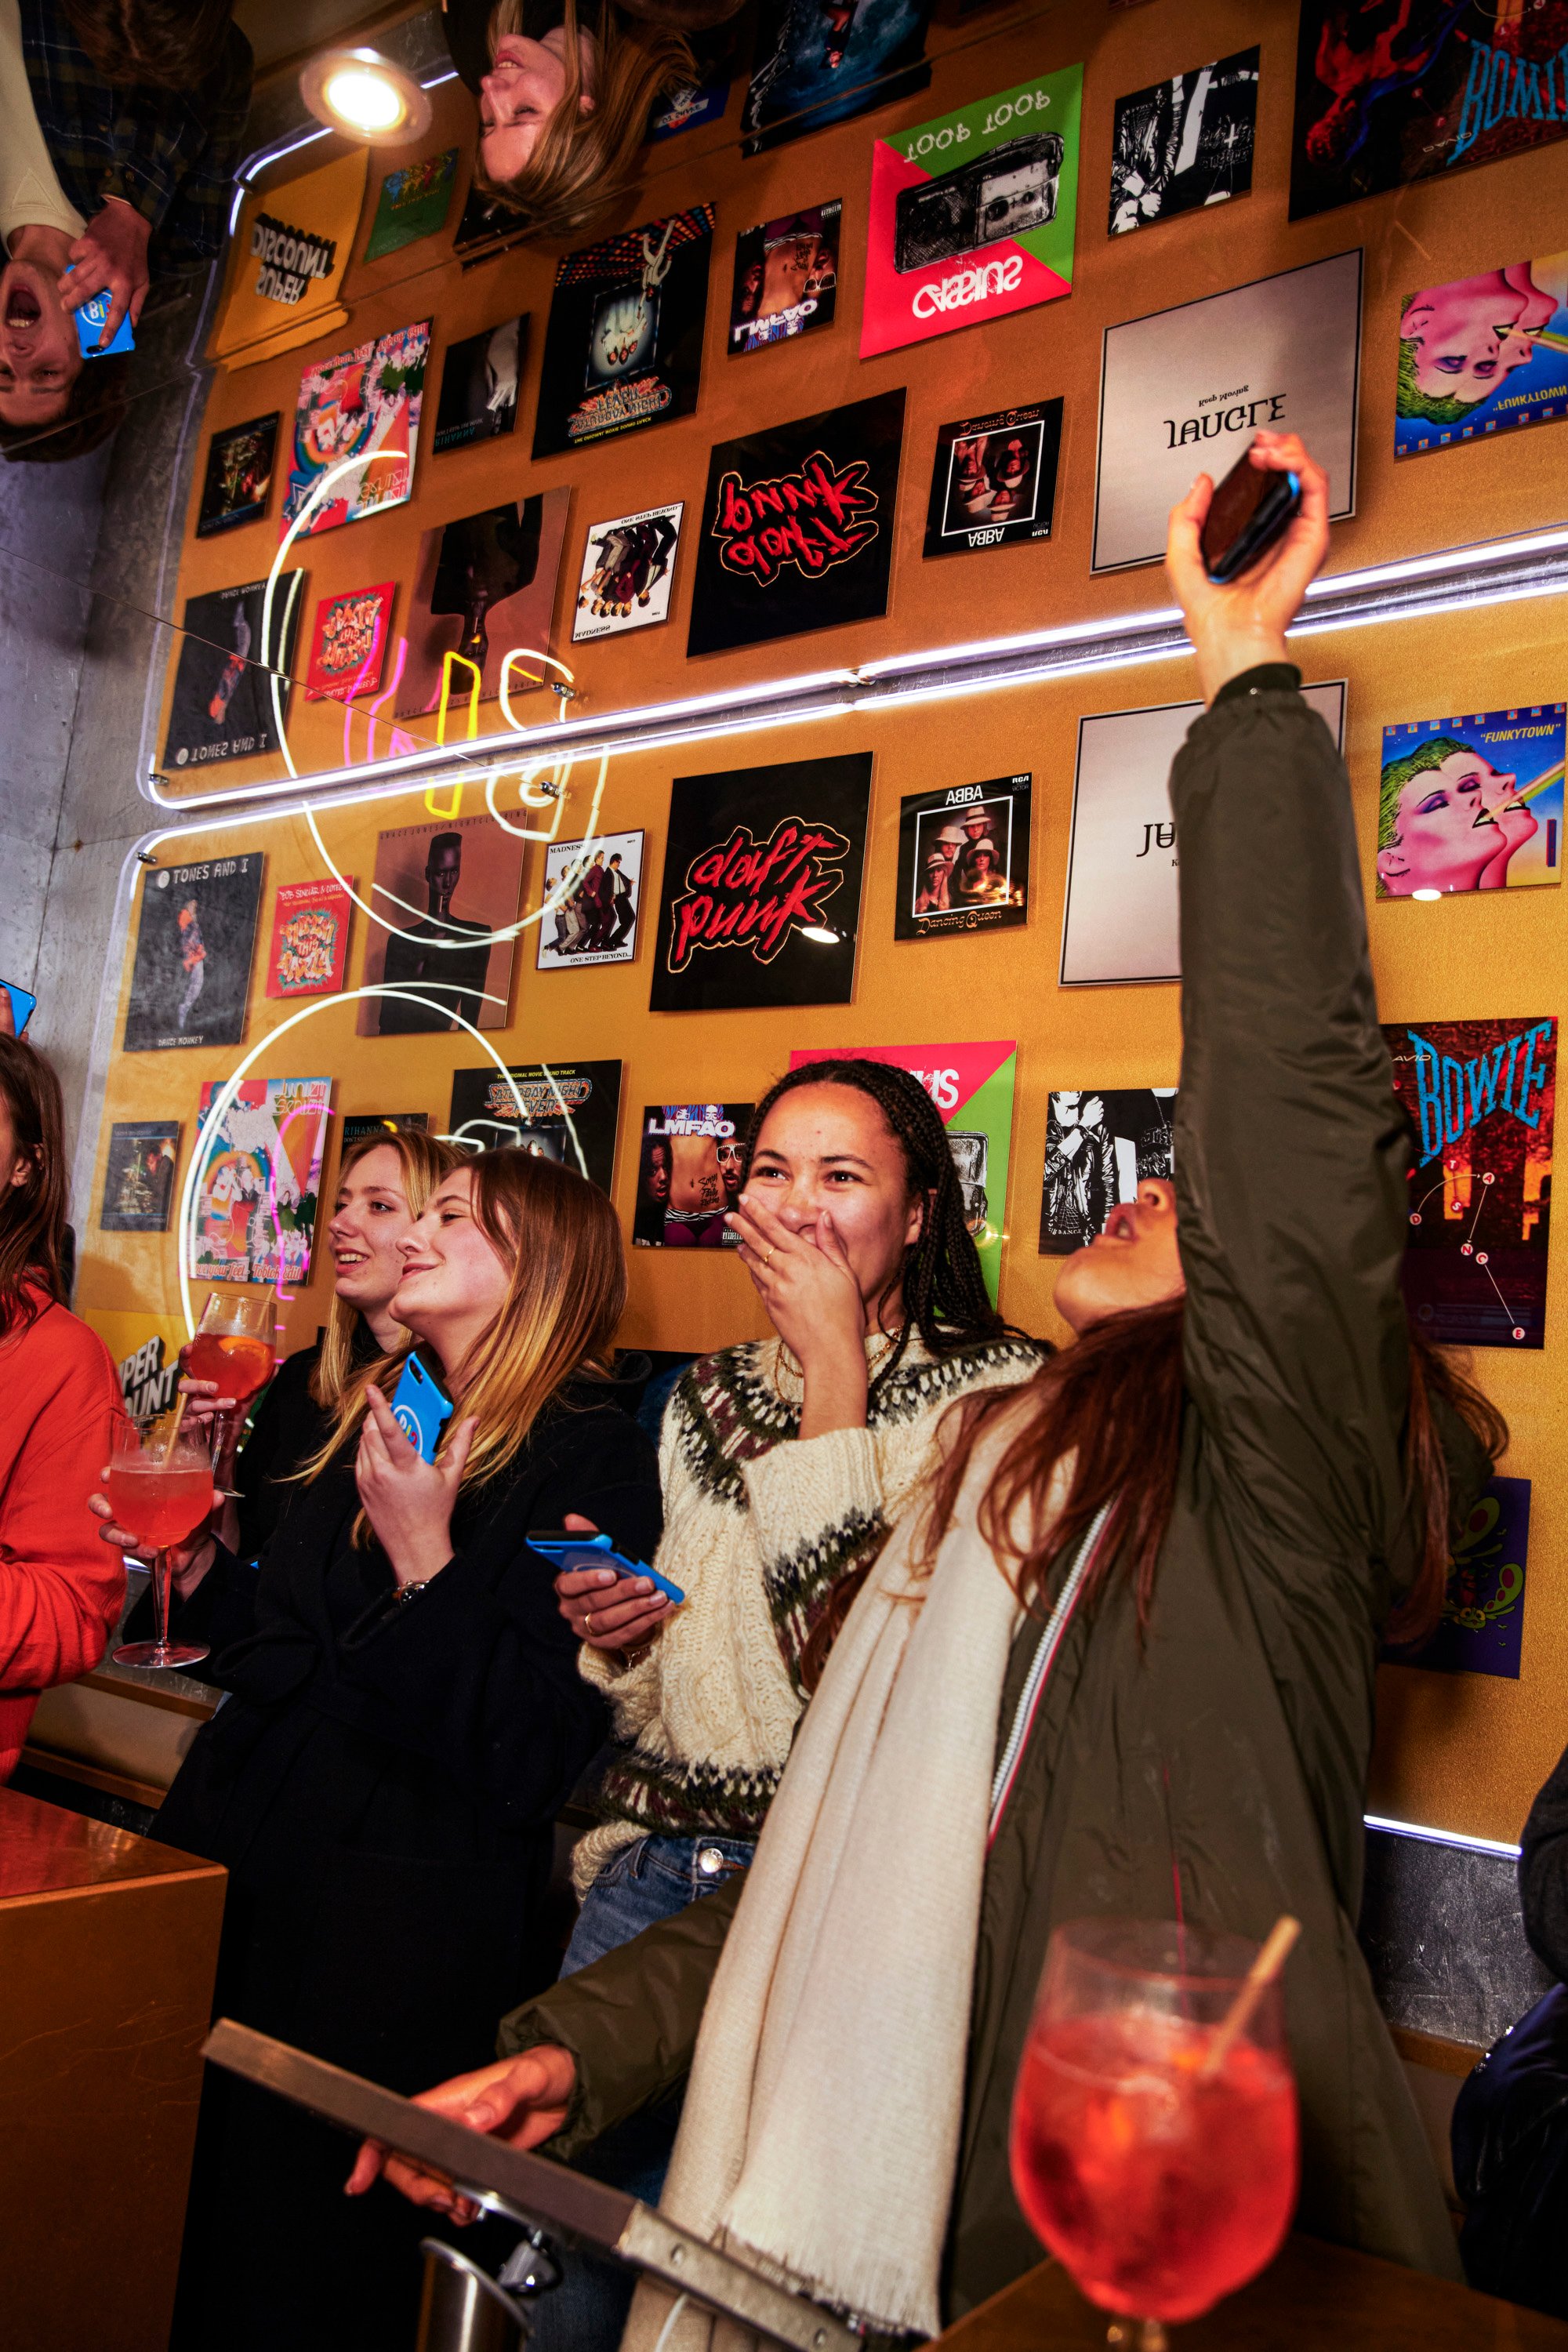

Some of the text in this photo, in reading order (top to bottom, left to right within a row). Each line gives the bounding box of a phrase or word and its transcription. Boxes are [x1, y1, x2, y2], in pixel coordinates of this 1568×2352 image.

[1011, 775, 1029, 784] RCA
[946, 785, 984, 806] ABBA
[380, 829, 408, 840] GRACE
[172, 858, 249, 884] TONES AND I
[694, 826, 840, 897] daft
[675, 864, 833, 963] punk
[916, 909, 1003, 936] Dancing Queen
[297, 939, 319, 956] THIS
[158, 1035, 204, 1047] DANCE MONKEY
[1392, 1054, 1432, 1062] AVID
[1407, 1019, 1552, 1169] BOWIE
[344, 1125, 385, 1136] RIHANNA
[648, 1118, 735, 1138] LMFAO
[208, 1264, 228, 1282] your
[227, 1262, 245, 1283] feet
